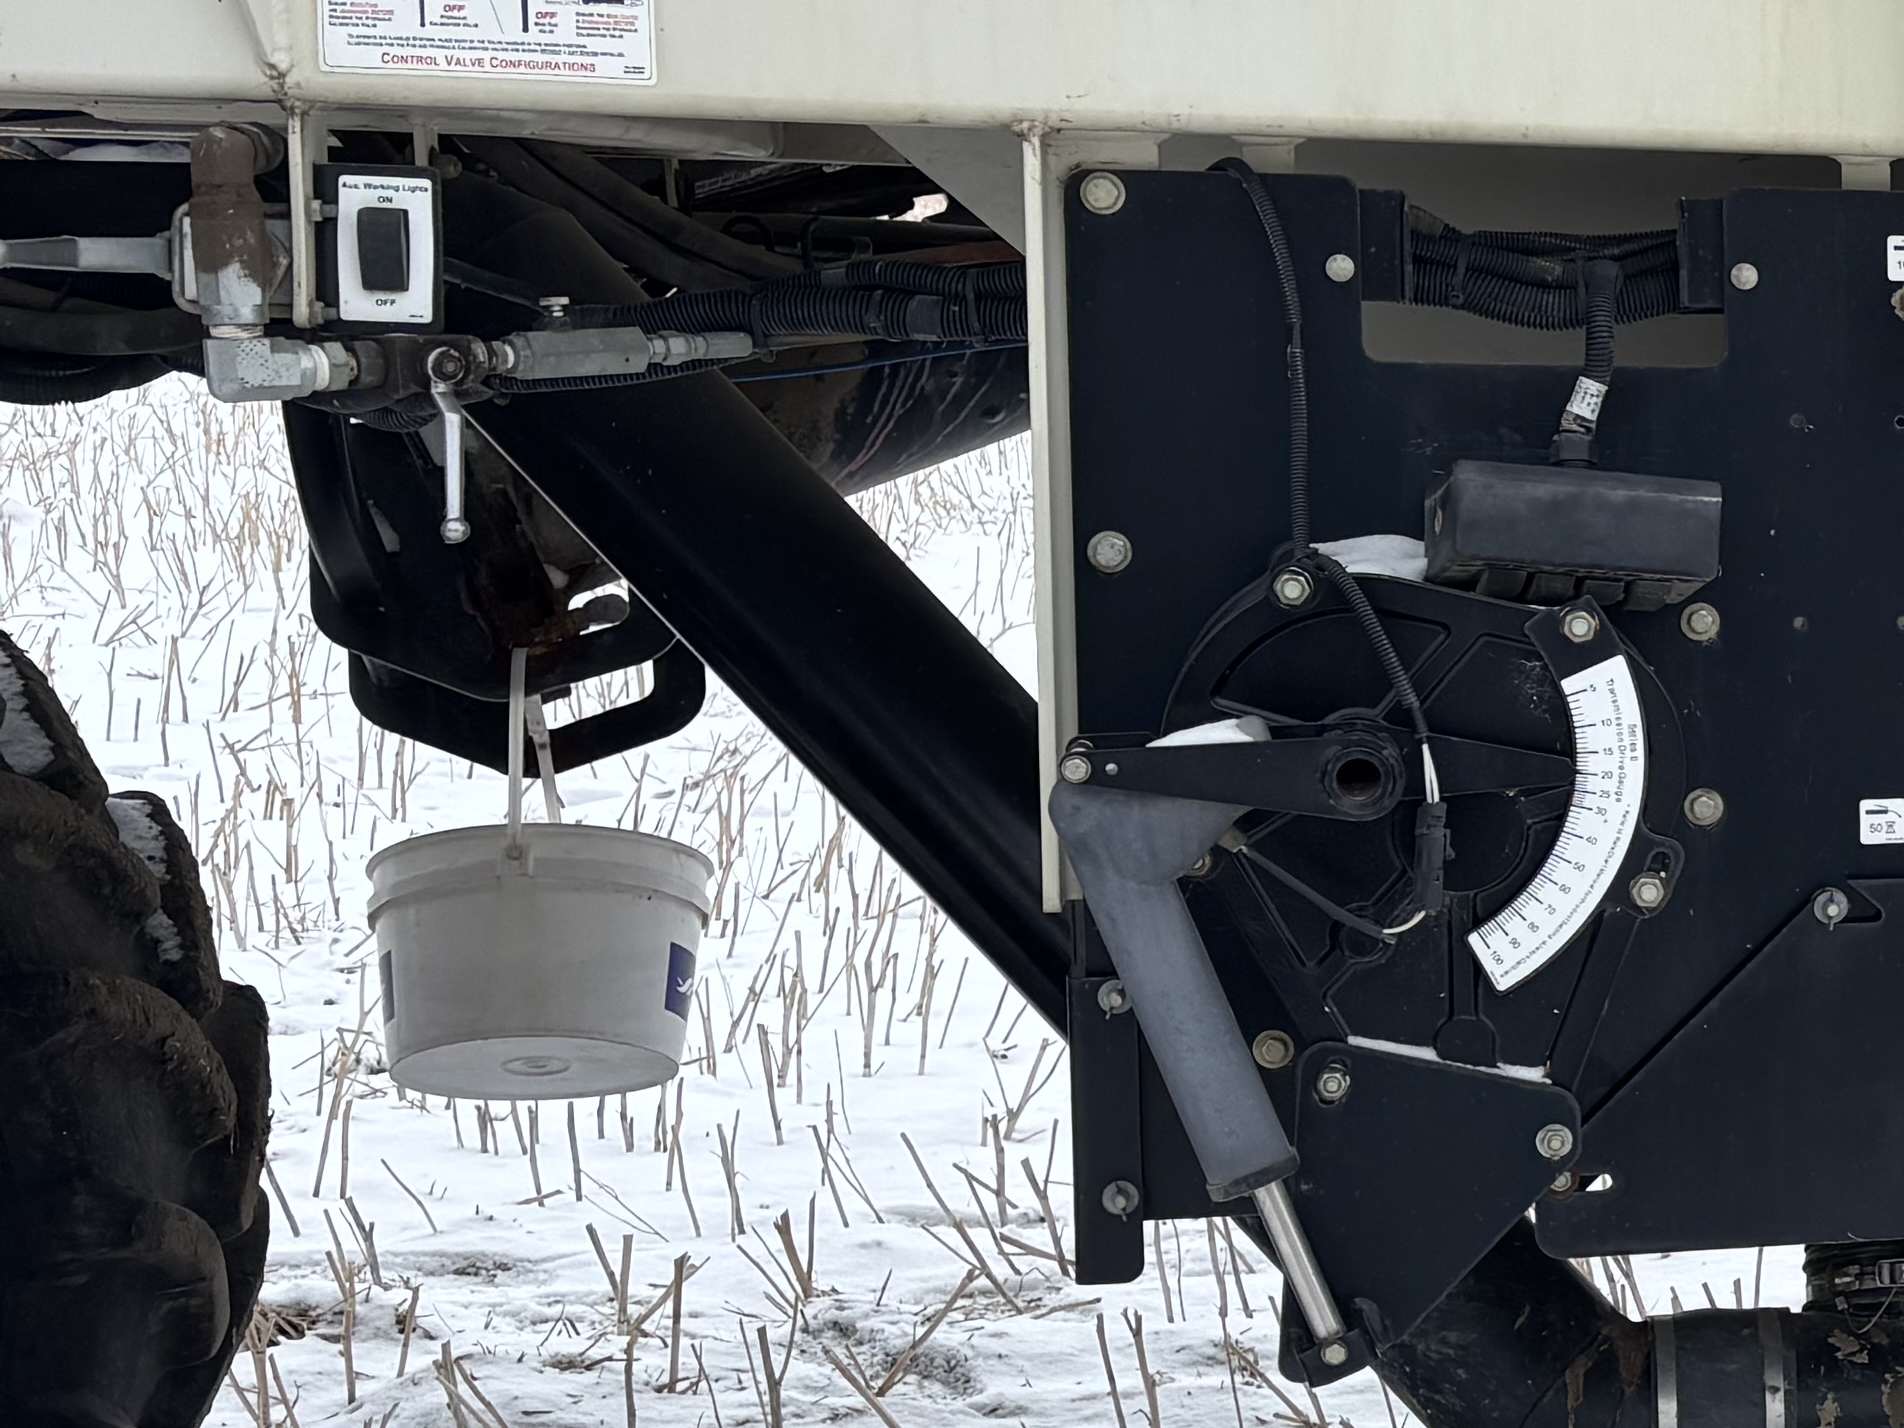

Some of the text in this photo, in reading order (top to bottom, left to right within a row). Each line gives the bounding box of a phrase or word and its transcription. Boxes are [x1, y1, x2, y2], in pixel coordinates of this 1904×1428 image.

[443, 4, 466, 13] OFF
[535, 11, 559, 20] OFF
[381, 52, 596, 72] CONTROL VALVE CONFIGURATIONS
[375, 298, 396, 307] OFF
[1589, 683, 1597, 693] 5
[1601, 718, 1612, 727] 10
[1603, 747, 1614, 756] 15
[1617, 745, 1627, 771] Drive
[1600, 770, 1613, 780] 20
[1869, 823, 1883, 833] 50
[1585, 835, 1598, 846] 40
[1573, 861, 1586, 872] 50
[1558, 883, 1572, 895] 60
[1544, 903, 1556, 916] 70
[1508, 937, 1521, 949] 90
[1489, 950, 1504, 965] 100
